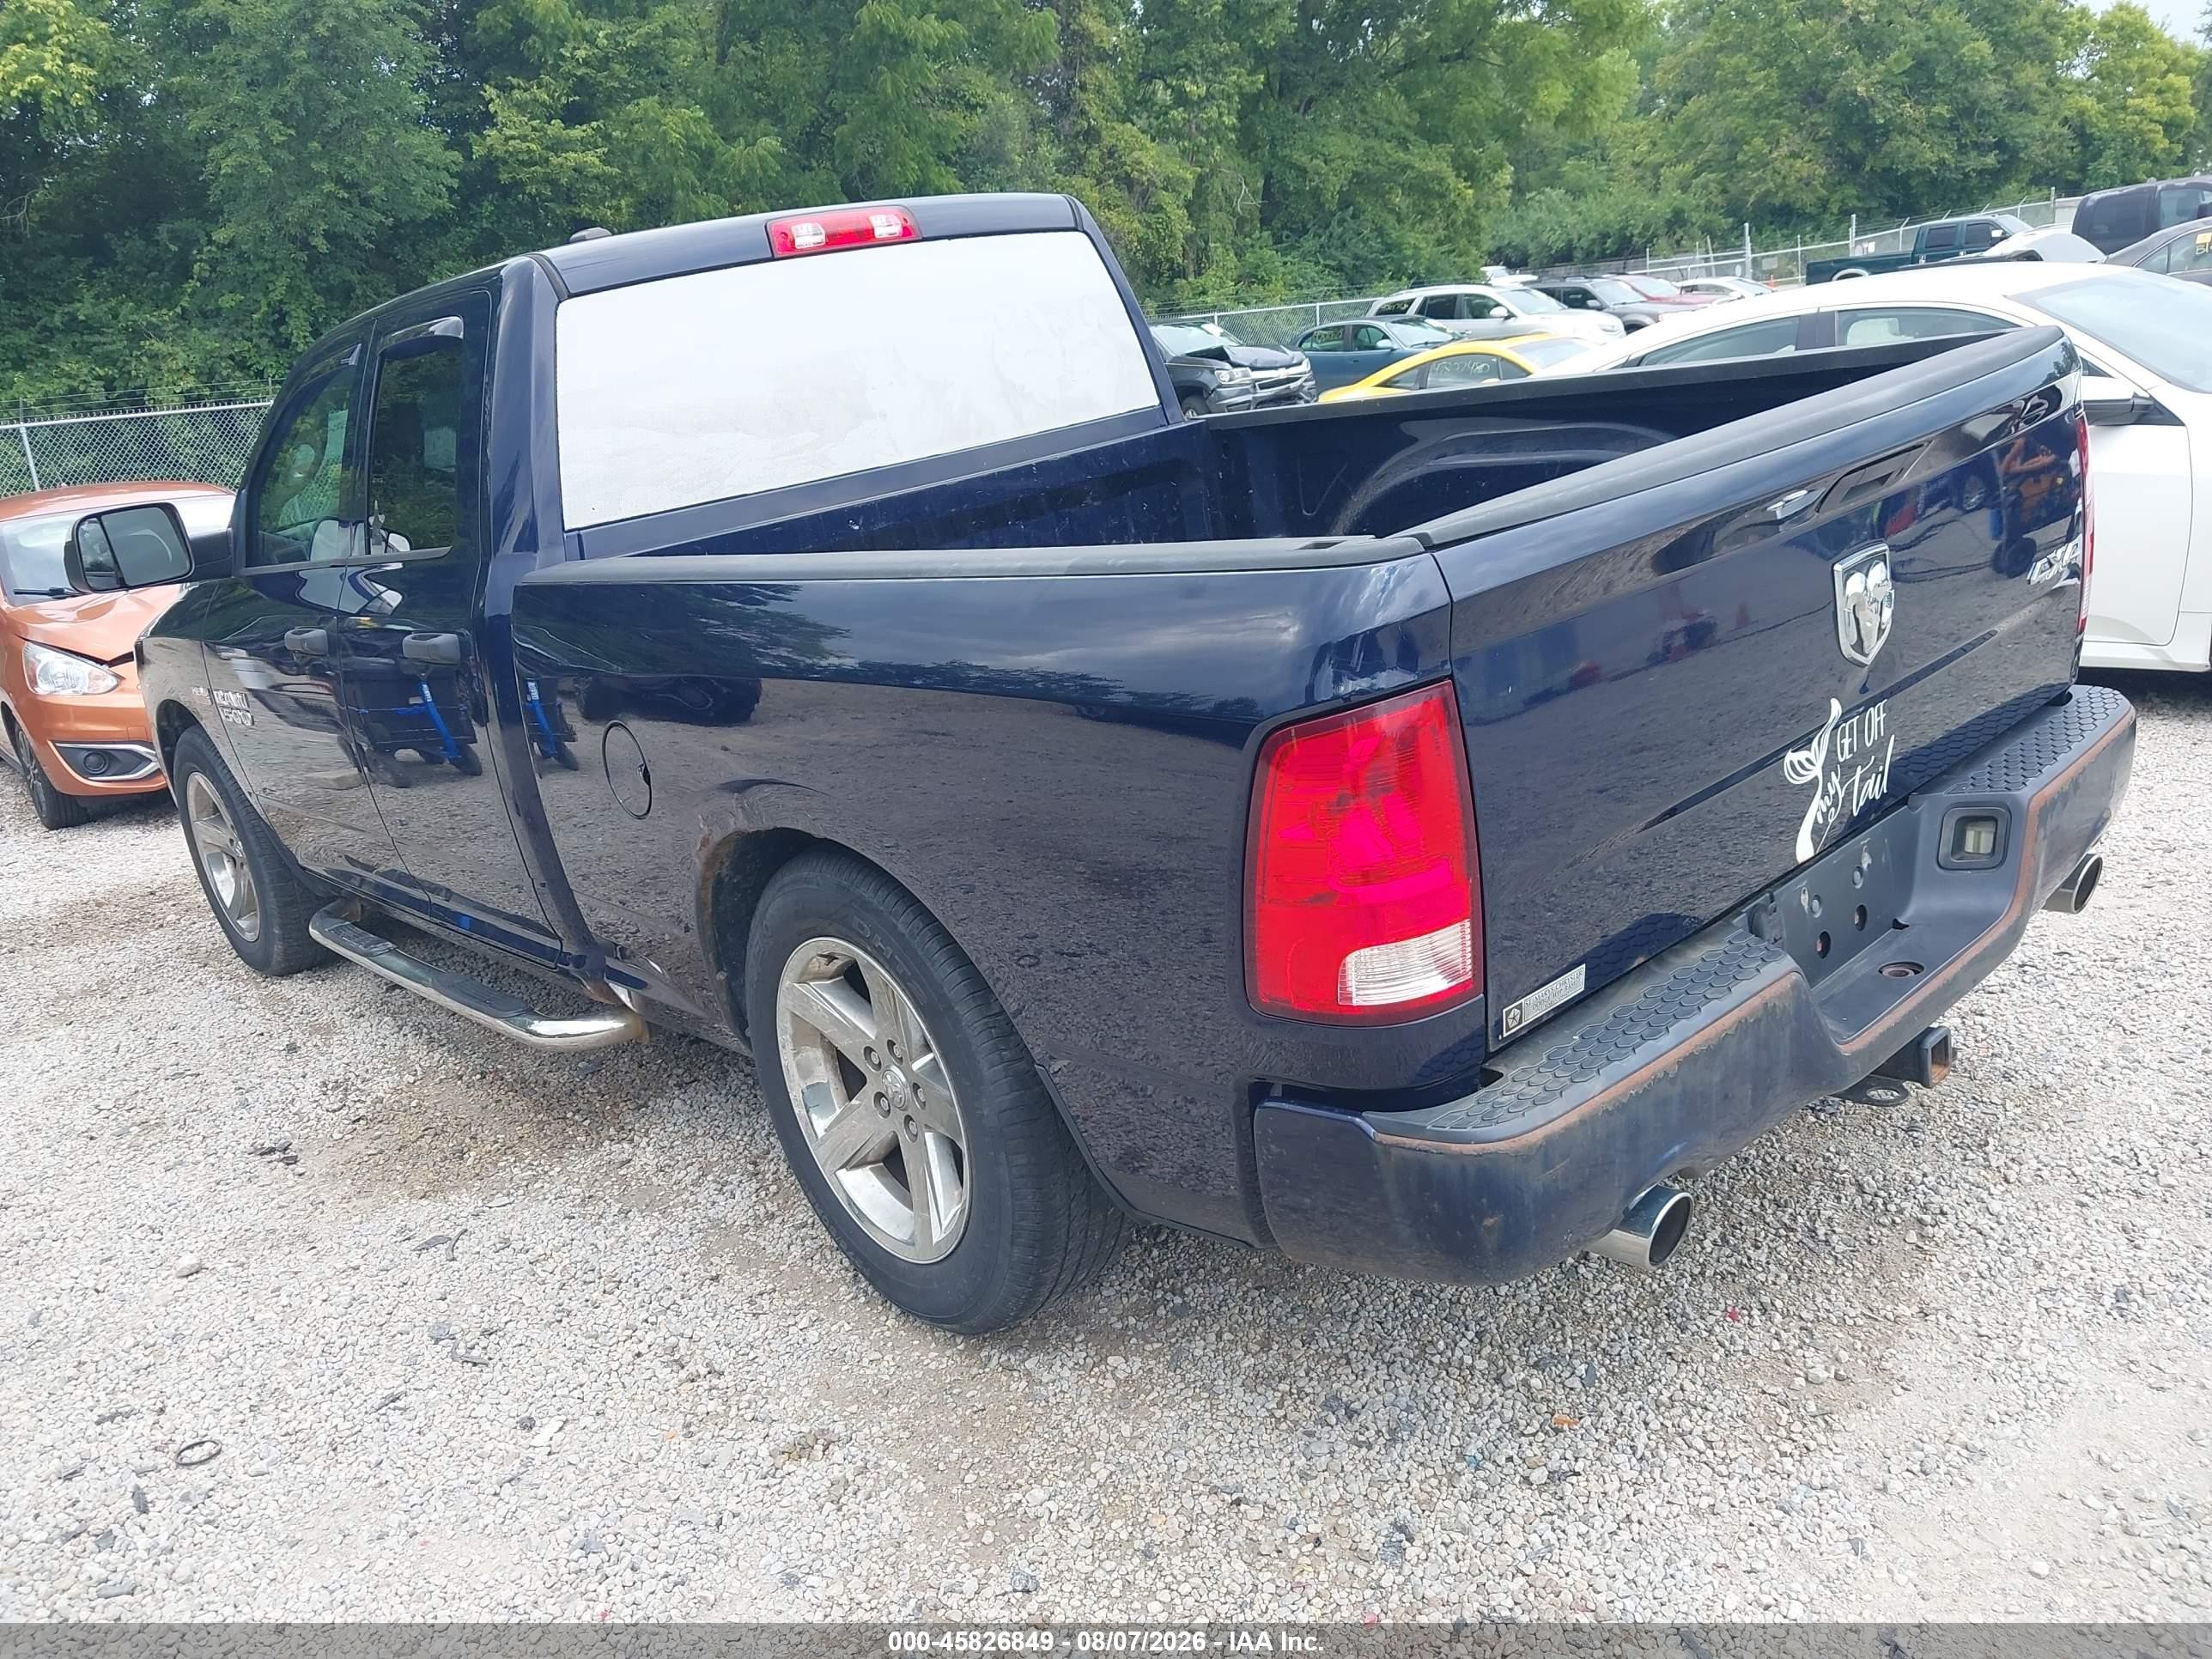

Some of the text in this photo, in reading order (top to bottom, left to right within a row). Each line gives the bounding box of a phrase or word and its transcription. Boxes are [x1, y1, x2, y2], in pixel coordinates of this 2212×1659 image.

[1836, 698, 1888, 763] GET OFF
[1816, 733, 1895, 825] my tail
